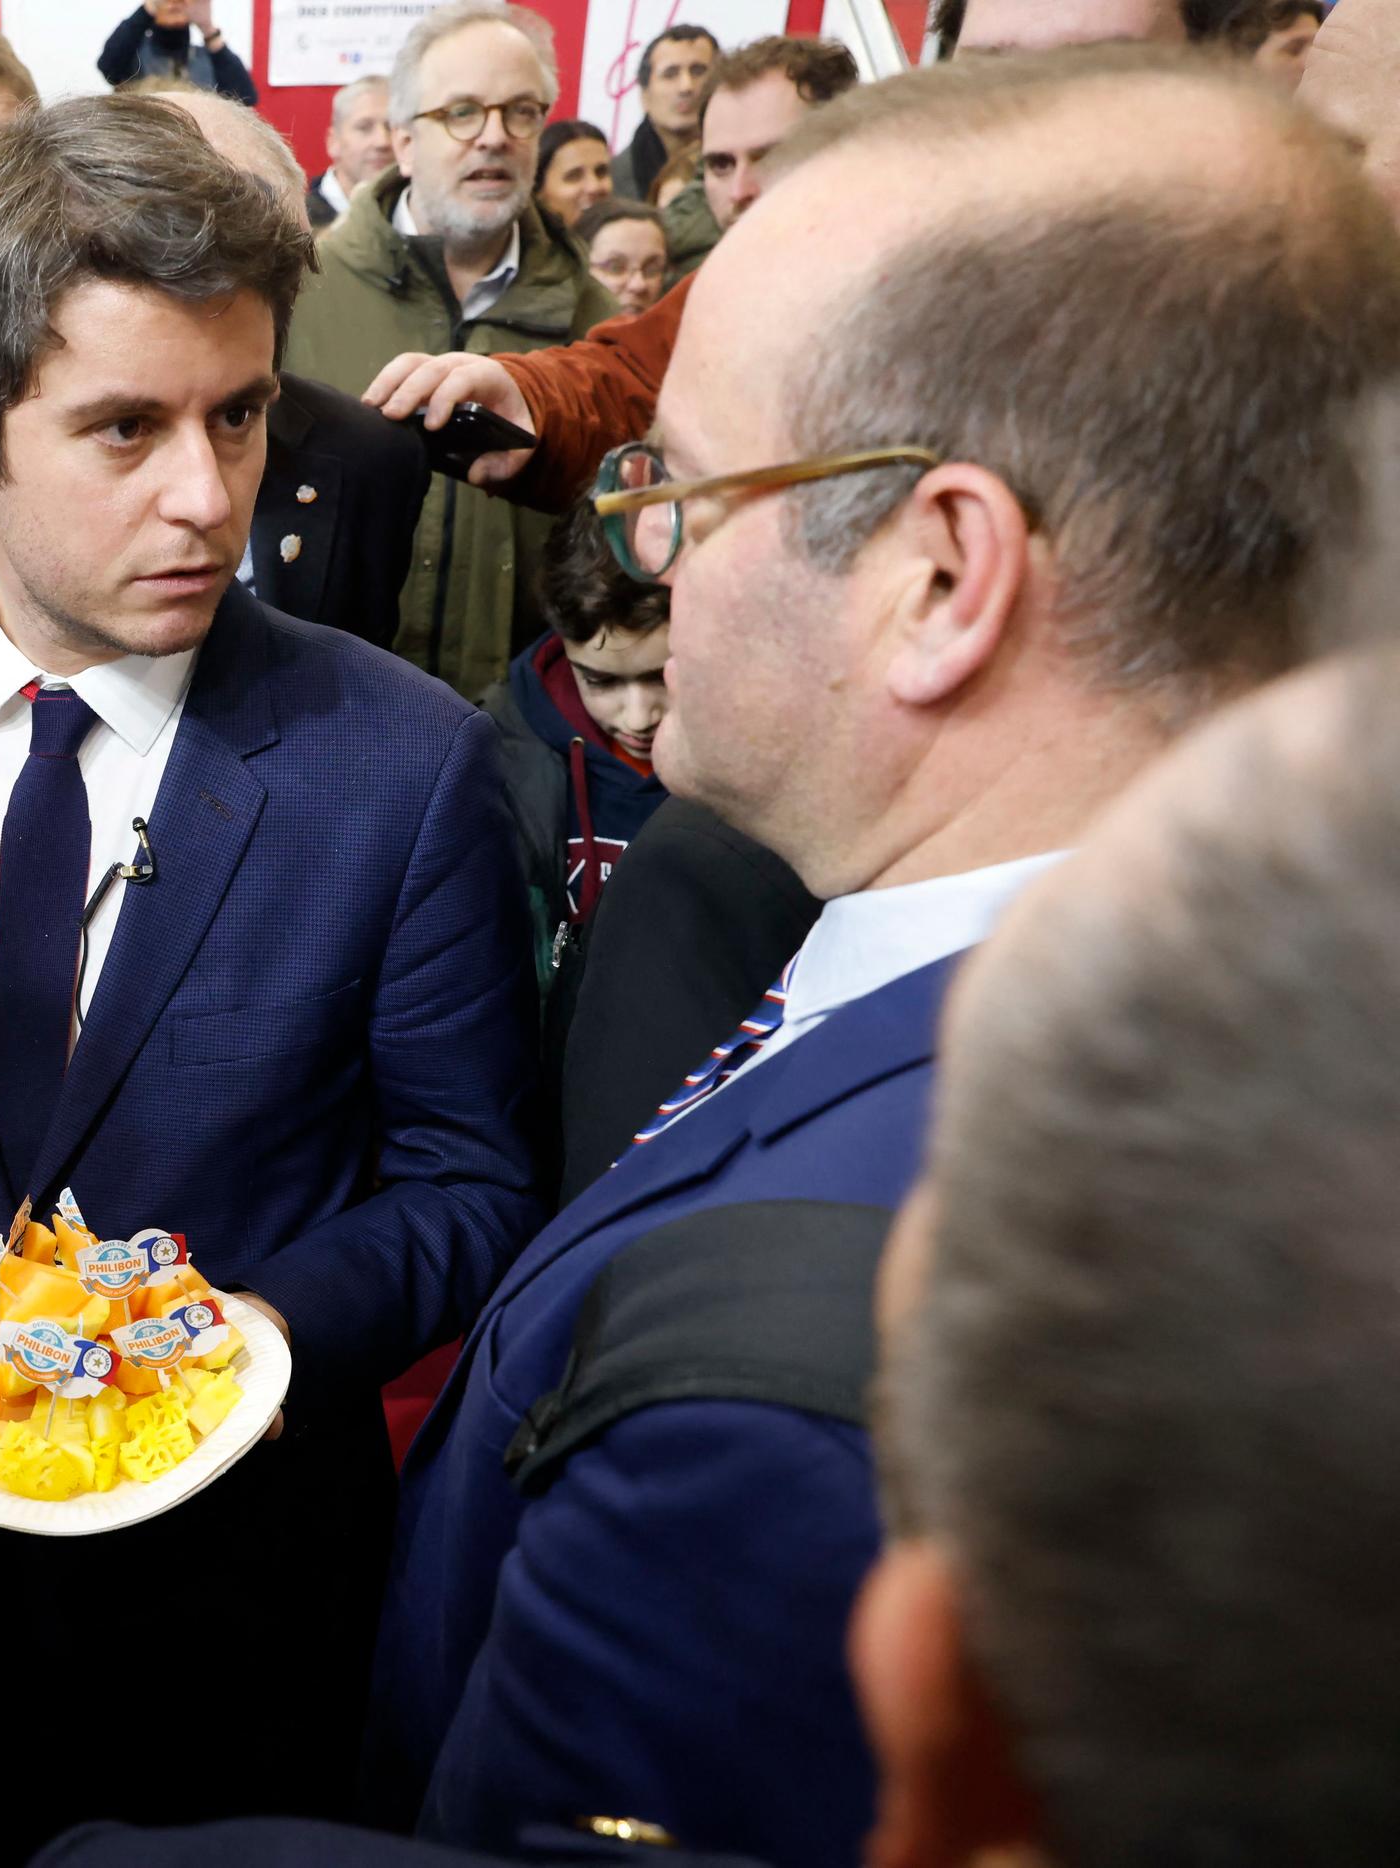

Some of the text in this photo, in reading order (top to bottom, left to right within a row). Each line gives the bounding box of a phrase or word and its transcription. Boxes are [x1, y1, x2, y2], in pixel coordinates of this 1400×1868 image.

[88, 1259, 141, 1273] PHILIBON
[16, 1334, 71, 1364] PHILIBON
[128, 1327, 180, 1350] PHILIBON
